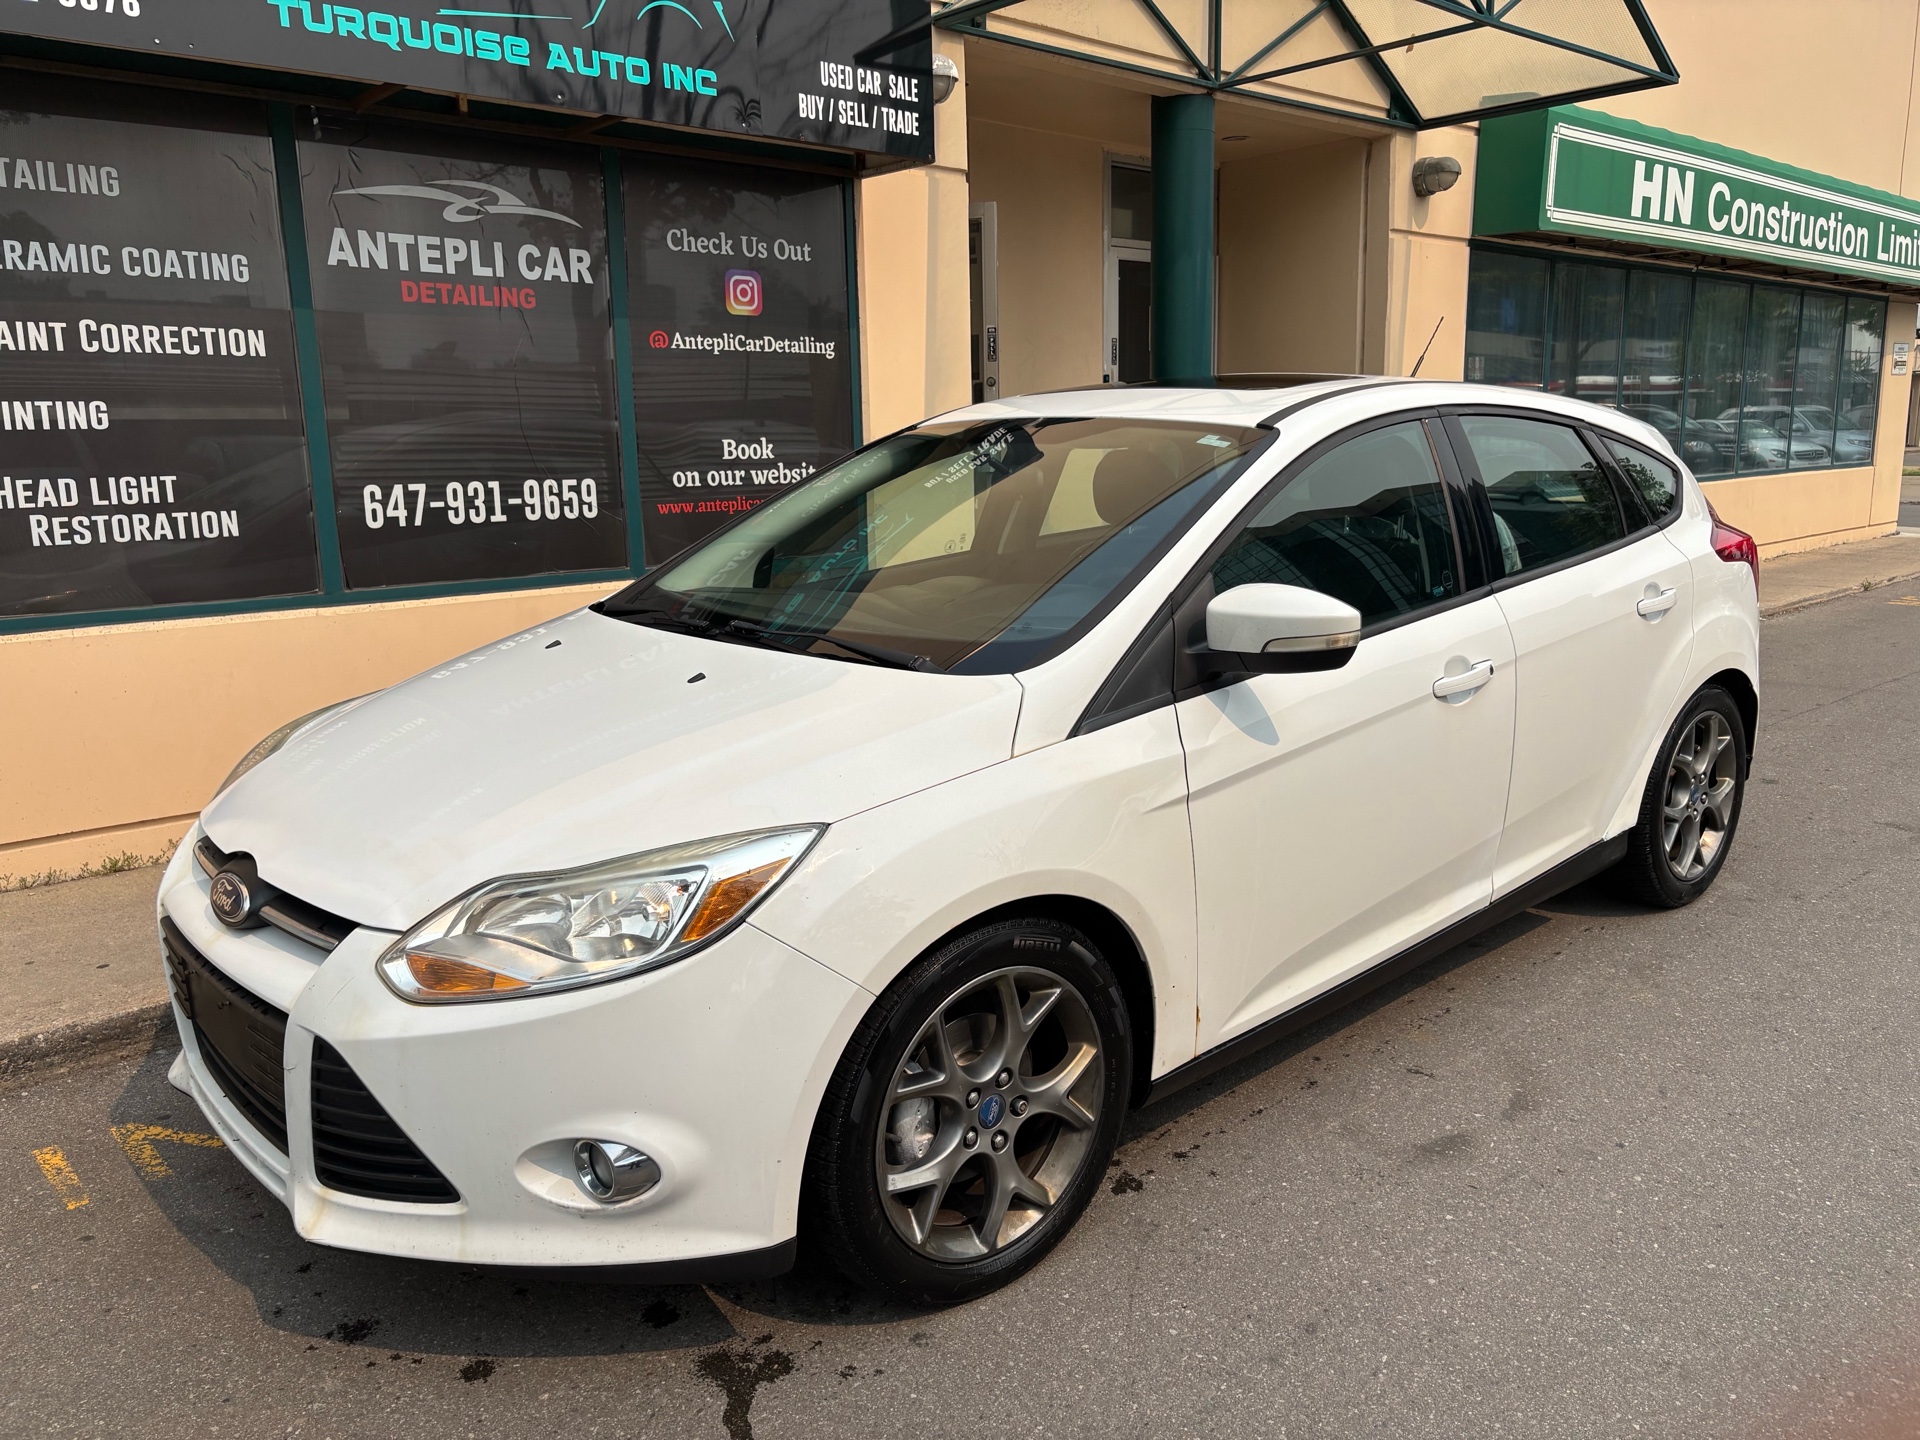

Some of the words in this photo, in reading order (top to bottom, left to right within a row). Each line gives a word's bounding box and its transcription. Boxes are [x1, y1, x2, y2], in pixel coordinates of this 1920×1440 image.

[547, 42, 650, 85] AUTO
[662, 63, 717, 96] INC
[820, 60, 853, 90] USED
[857, 68, 882, 95] CAR
[889, 74, 918, 102] SALE
[799, 92, 824, 120] BUY
[828, 98, 834, 122] /
[838, 99, 869, 127] SELL
[872, 105, 878, 129] /
[881, 106, 919, 136] TRADE
[0, 157, 120, 197] TAILING
[1630, 159, 1695, 225] HN
[1707, 181, 1868, 258] Construction
[0, 240, 110, 275] RAMIC
[122, 246, 250, 283] COATING
[327, 227, 504, 278] ANTEPLI
[517, 244, 594, 284] CAR
[666, 228, 734, 256] Check
[741, 235, 767, 258] Us
[774, 238, 811, 262] Out
[400, 280, 537, 309] DETAILING
[0, 320, 67, 352] AINT
[78, 318, 267, 357] CORRECTION
[2, 400, 109, 431] INTING
[722, 437, 775, 460] Book
[0, 476, 78, 510] HEAD
[89, 475, 177, 506] LIGHT
[672, 470, 702, 487] on
[706, 469, 746, 487] our
[363, 477, 599, 530] 647-931-9659
[657, 496, 765, 515] www.anteplic
[29, 510, 240, 547] RESTORATION
[212, 878, 234, 912] Ford
[1013, 934, 1062, 952] PIRELLI
